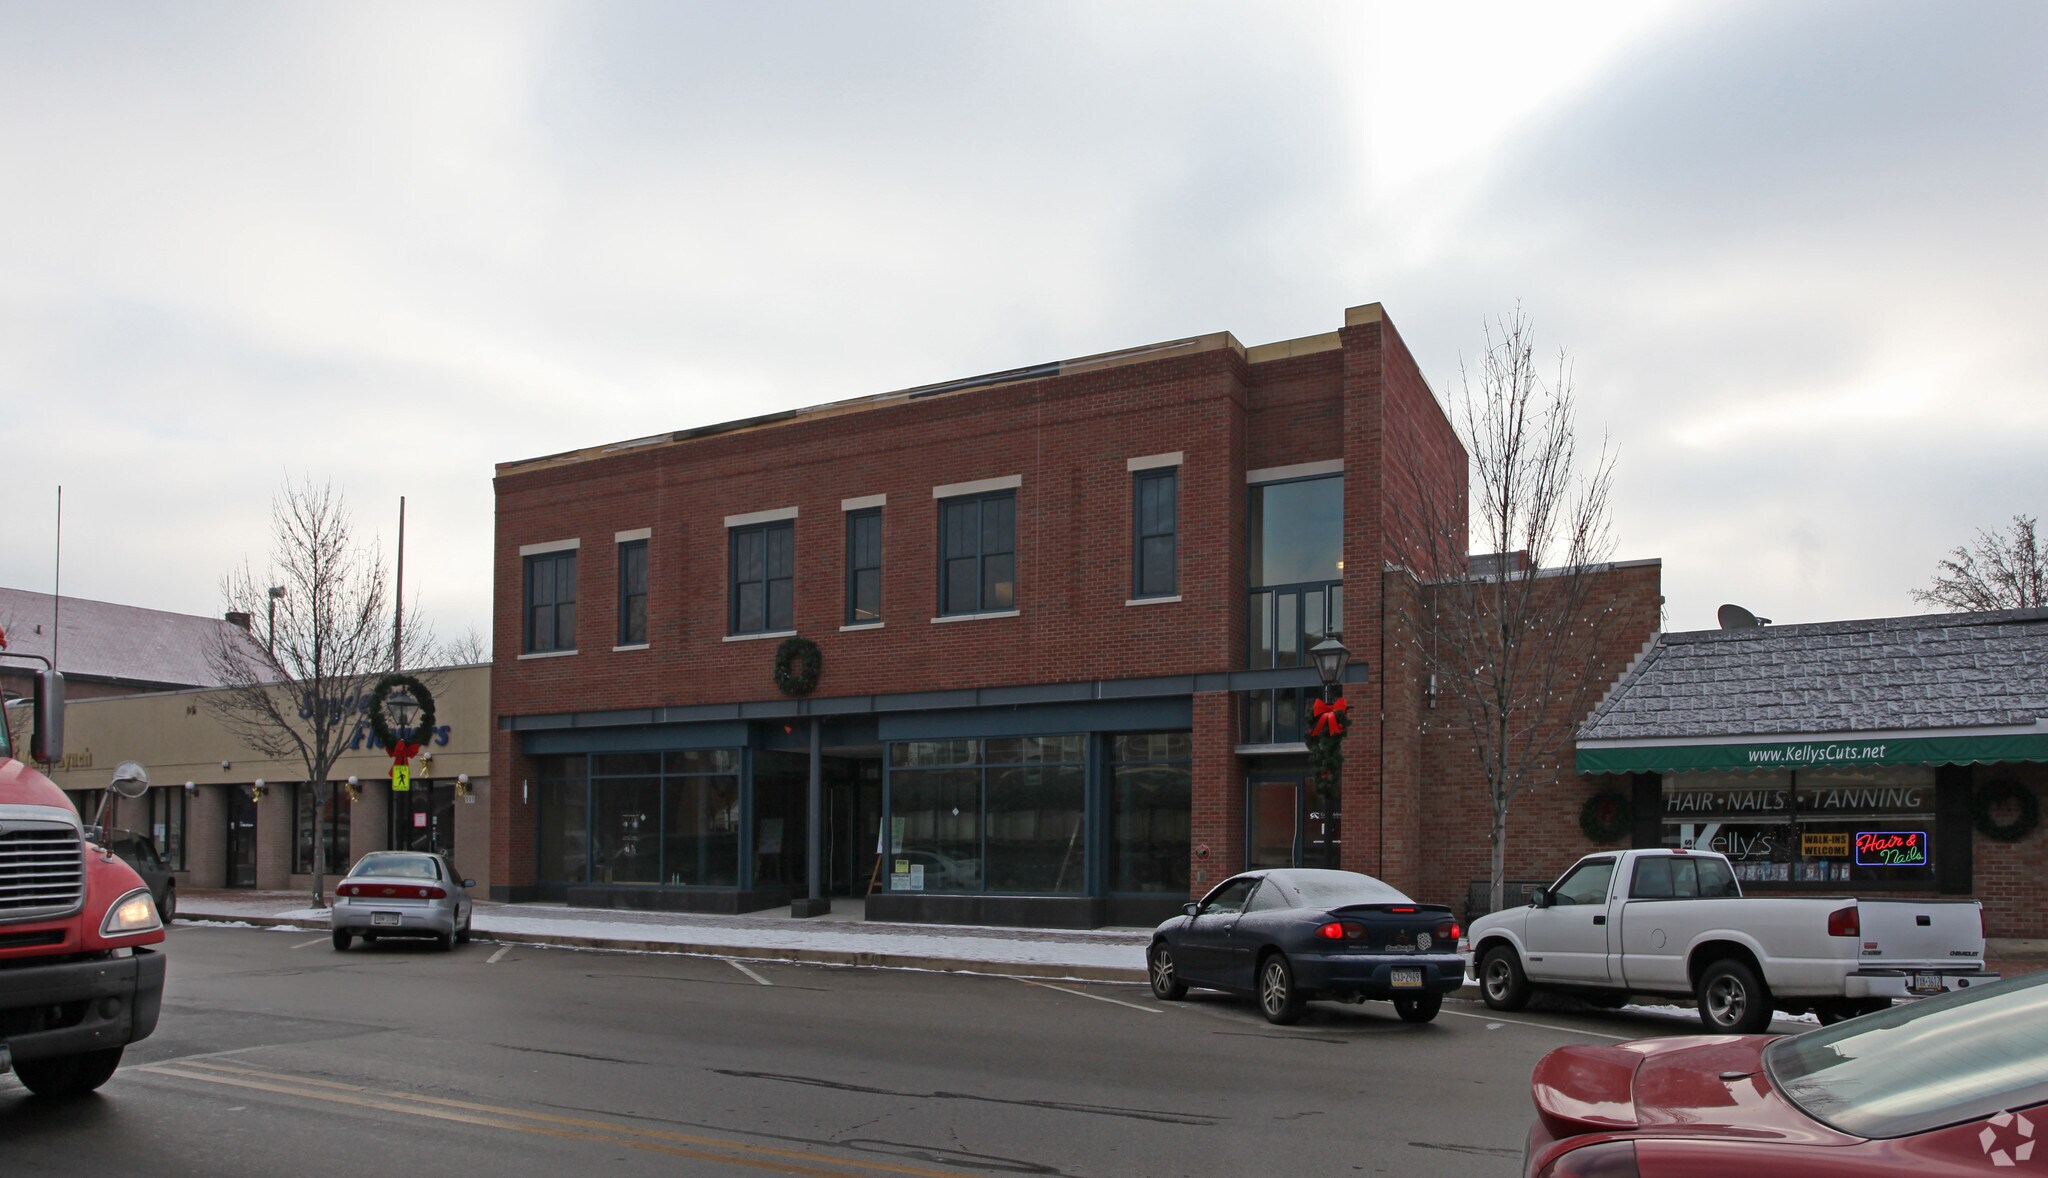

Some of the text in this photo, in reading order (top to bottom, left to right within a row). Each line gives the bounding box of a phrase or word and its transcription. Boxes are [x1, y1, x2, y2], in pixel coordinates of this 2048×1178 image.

[350, 721, 451, 750] Flowrs
[1748, 744, 1886, 764] www.KellysCuts.net
[1667, 787, 1923, 811] HAIR NAILS TANNING
[1804, 835, 1847, 844] WALK-INS
[1856, 833, 1917, 854] Hair &
[1804, 846, 1847, 855] WELCOME
[1880, 846, 1924, 865] Nails
